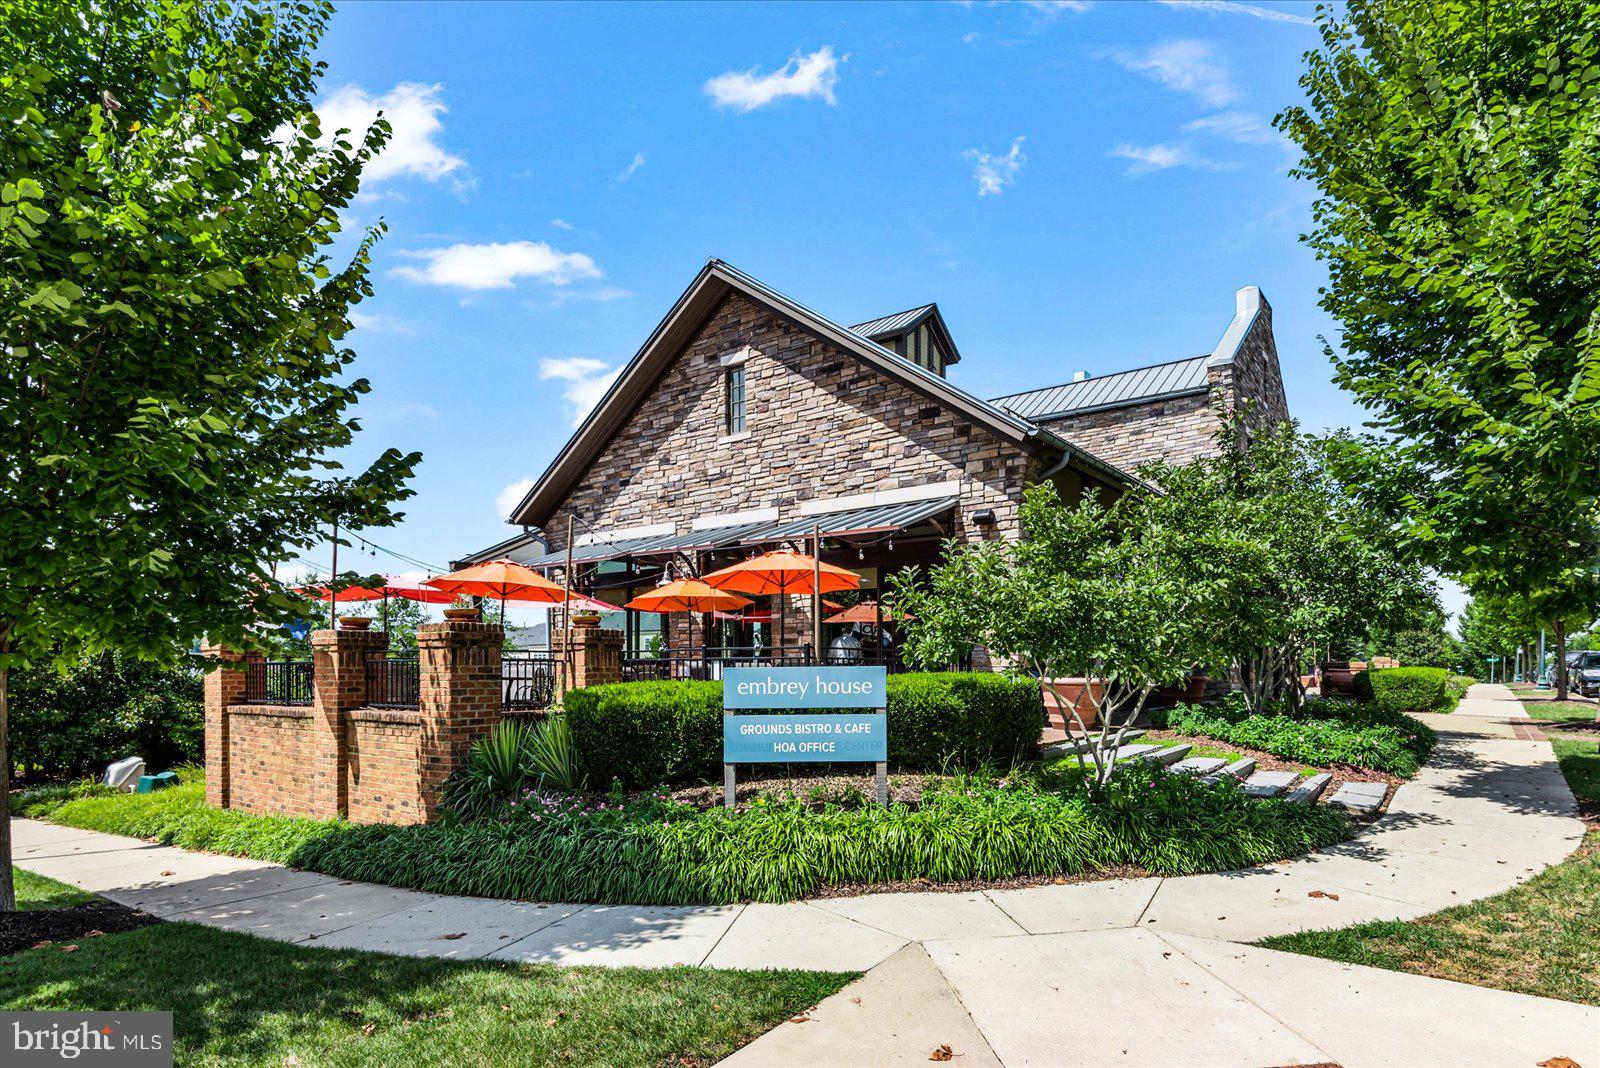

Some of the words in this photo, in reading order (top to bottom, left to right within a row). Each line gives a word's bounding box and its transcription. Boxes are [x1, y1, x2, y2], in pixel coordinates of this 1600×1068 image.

[737, 676, 809, 700] embrey
[816, 675, 873, 695] house
[740, 723, 792, 735] GROUNDS
[795, 723, 832, 735] BISTRO
[834, 723, 842, 734] &
[844, 723, 871, 734] CAFE
[773, 742, 796, 753] HOA
[799, 742, 835, 753] OFFICE
